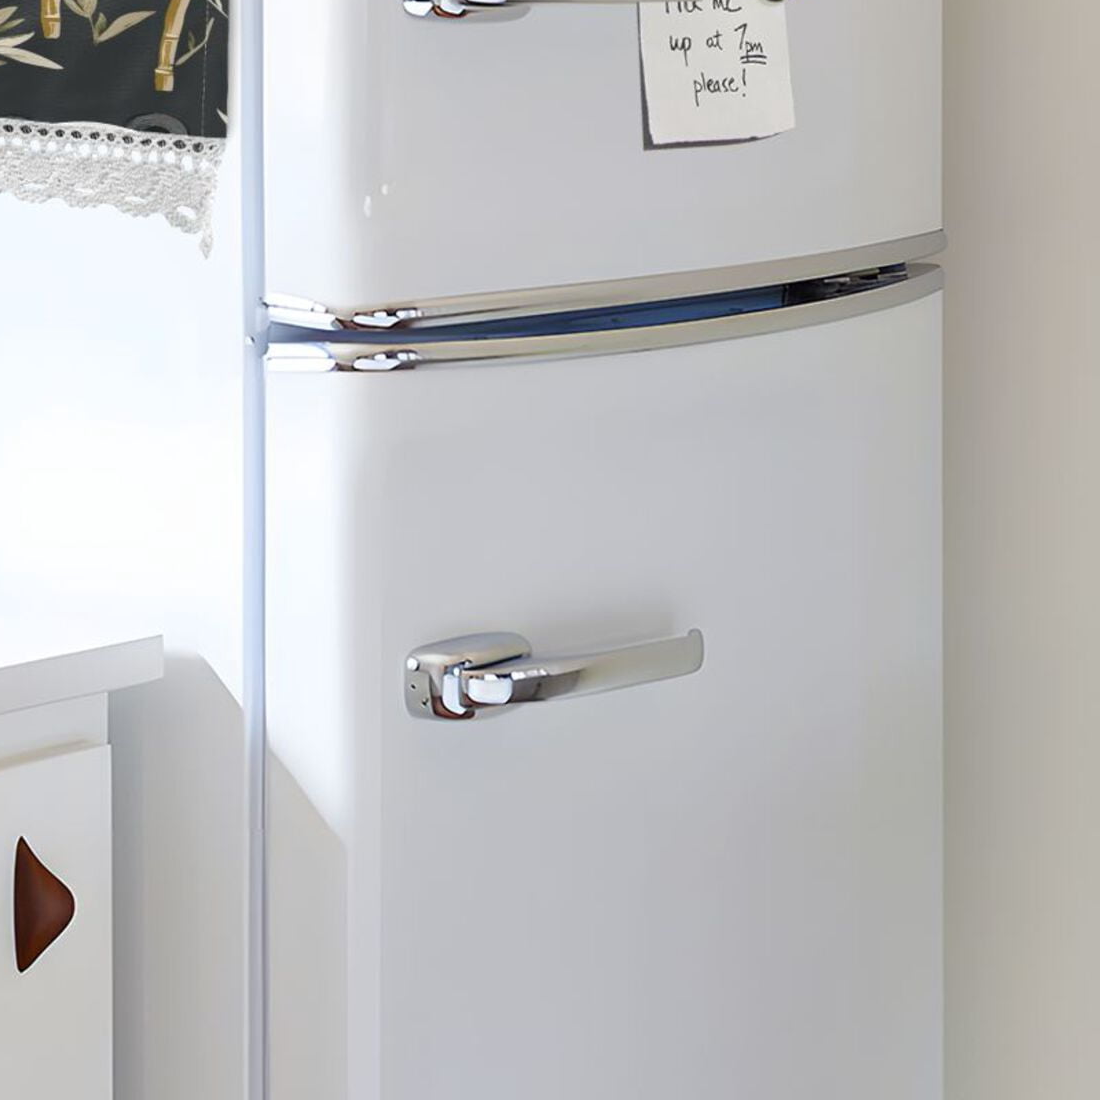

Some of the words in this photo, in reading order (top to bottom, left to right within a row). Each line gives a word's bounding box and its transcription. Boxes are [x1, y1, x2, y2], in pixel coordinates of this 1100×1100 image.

[669, 35, 692, 66] up
[706, 30, 723, 51] at
[693, 68, 746, 107] please!
